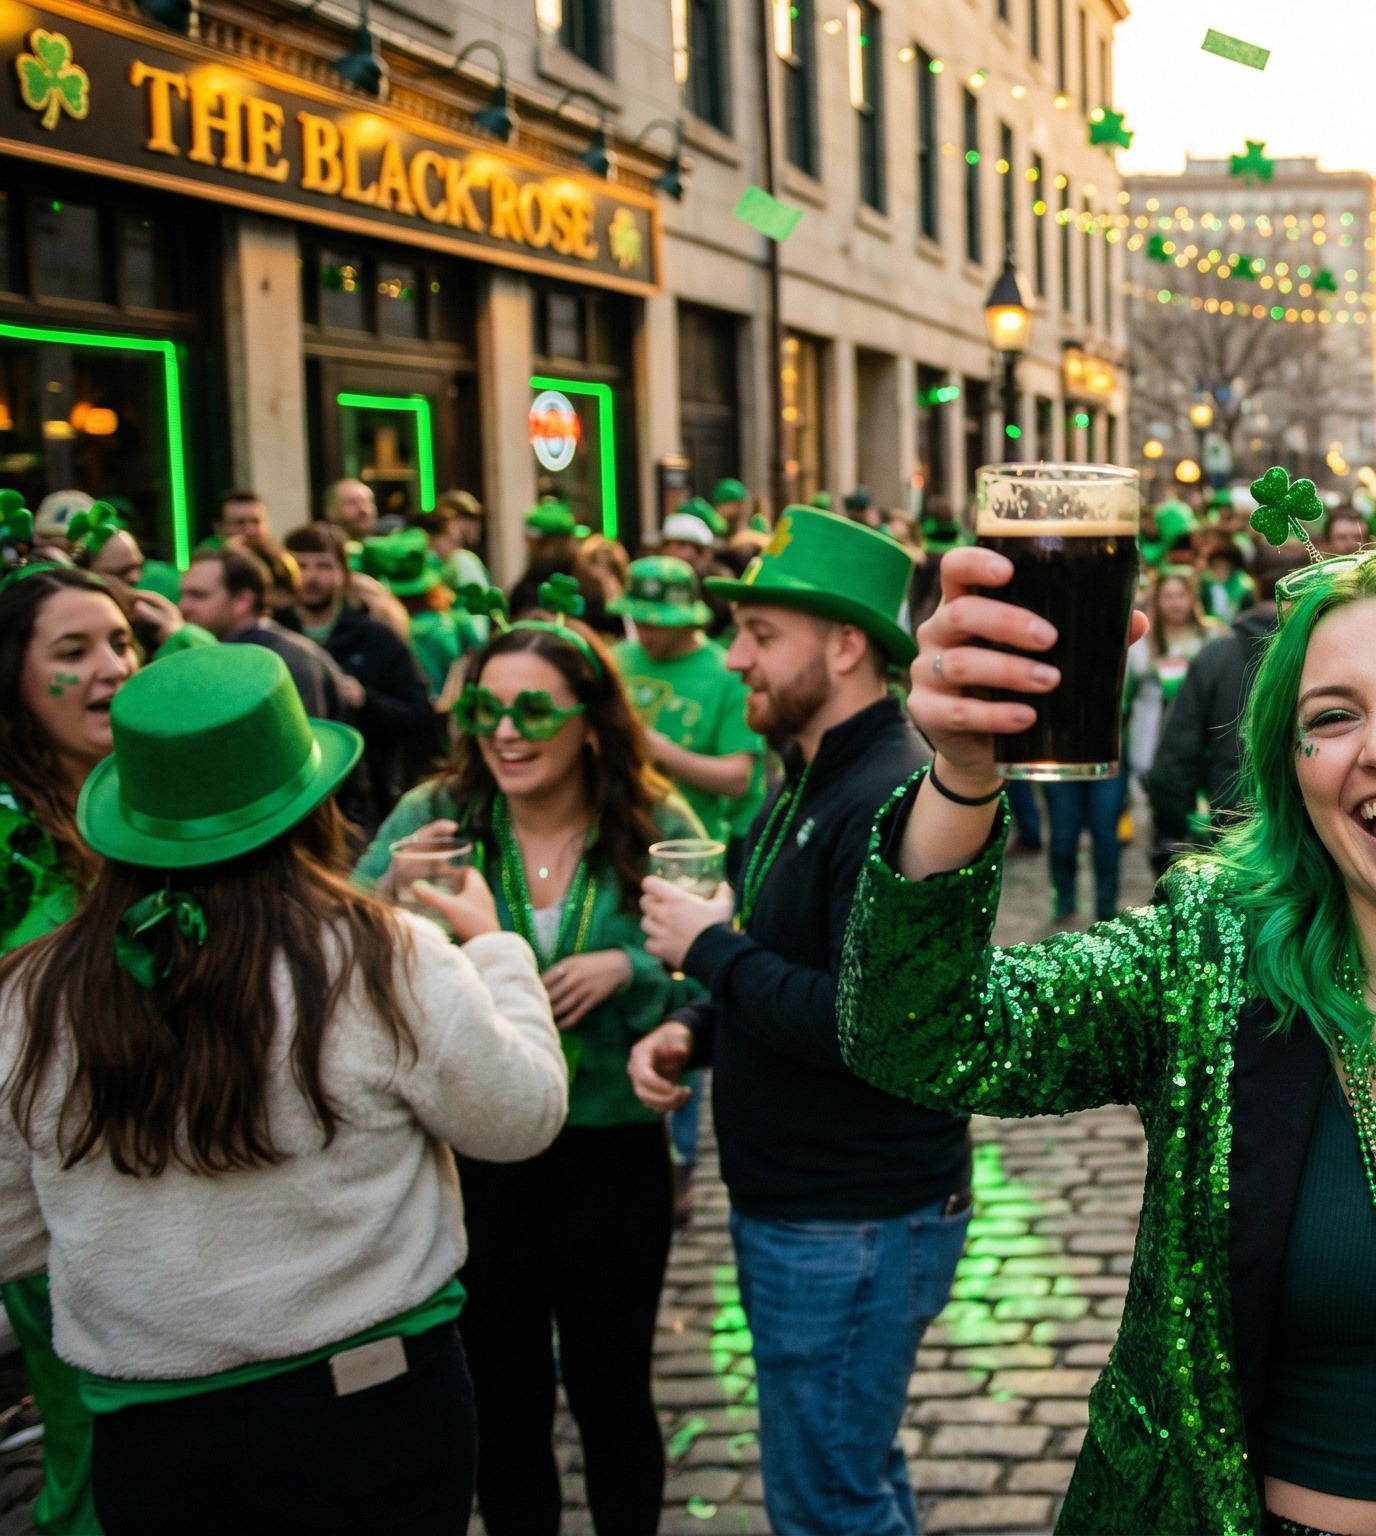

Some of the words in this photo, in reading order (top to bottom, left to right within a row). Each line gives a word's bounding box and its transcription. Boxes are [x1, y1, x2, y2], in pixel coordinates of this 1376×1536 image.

[129, 60, 290, 183] THE
[298, 111, 485, 233] BLACK
[486, 170, 598, 261] ROSE
